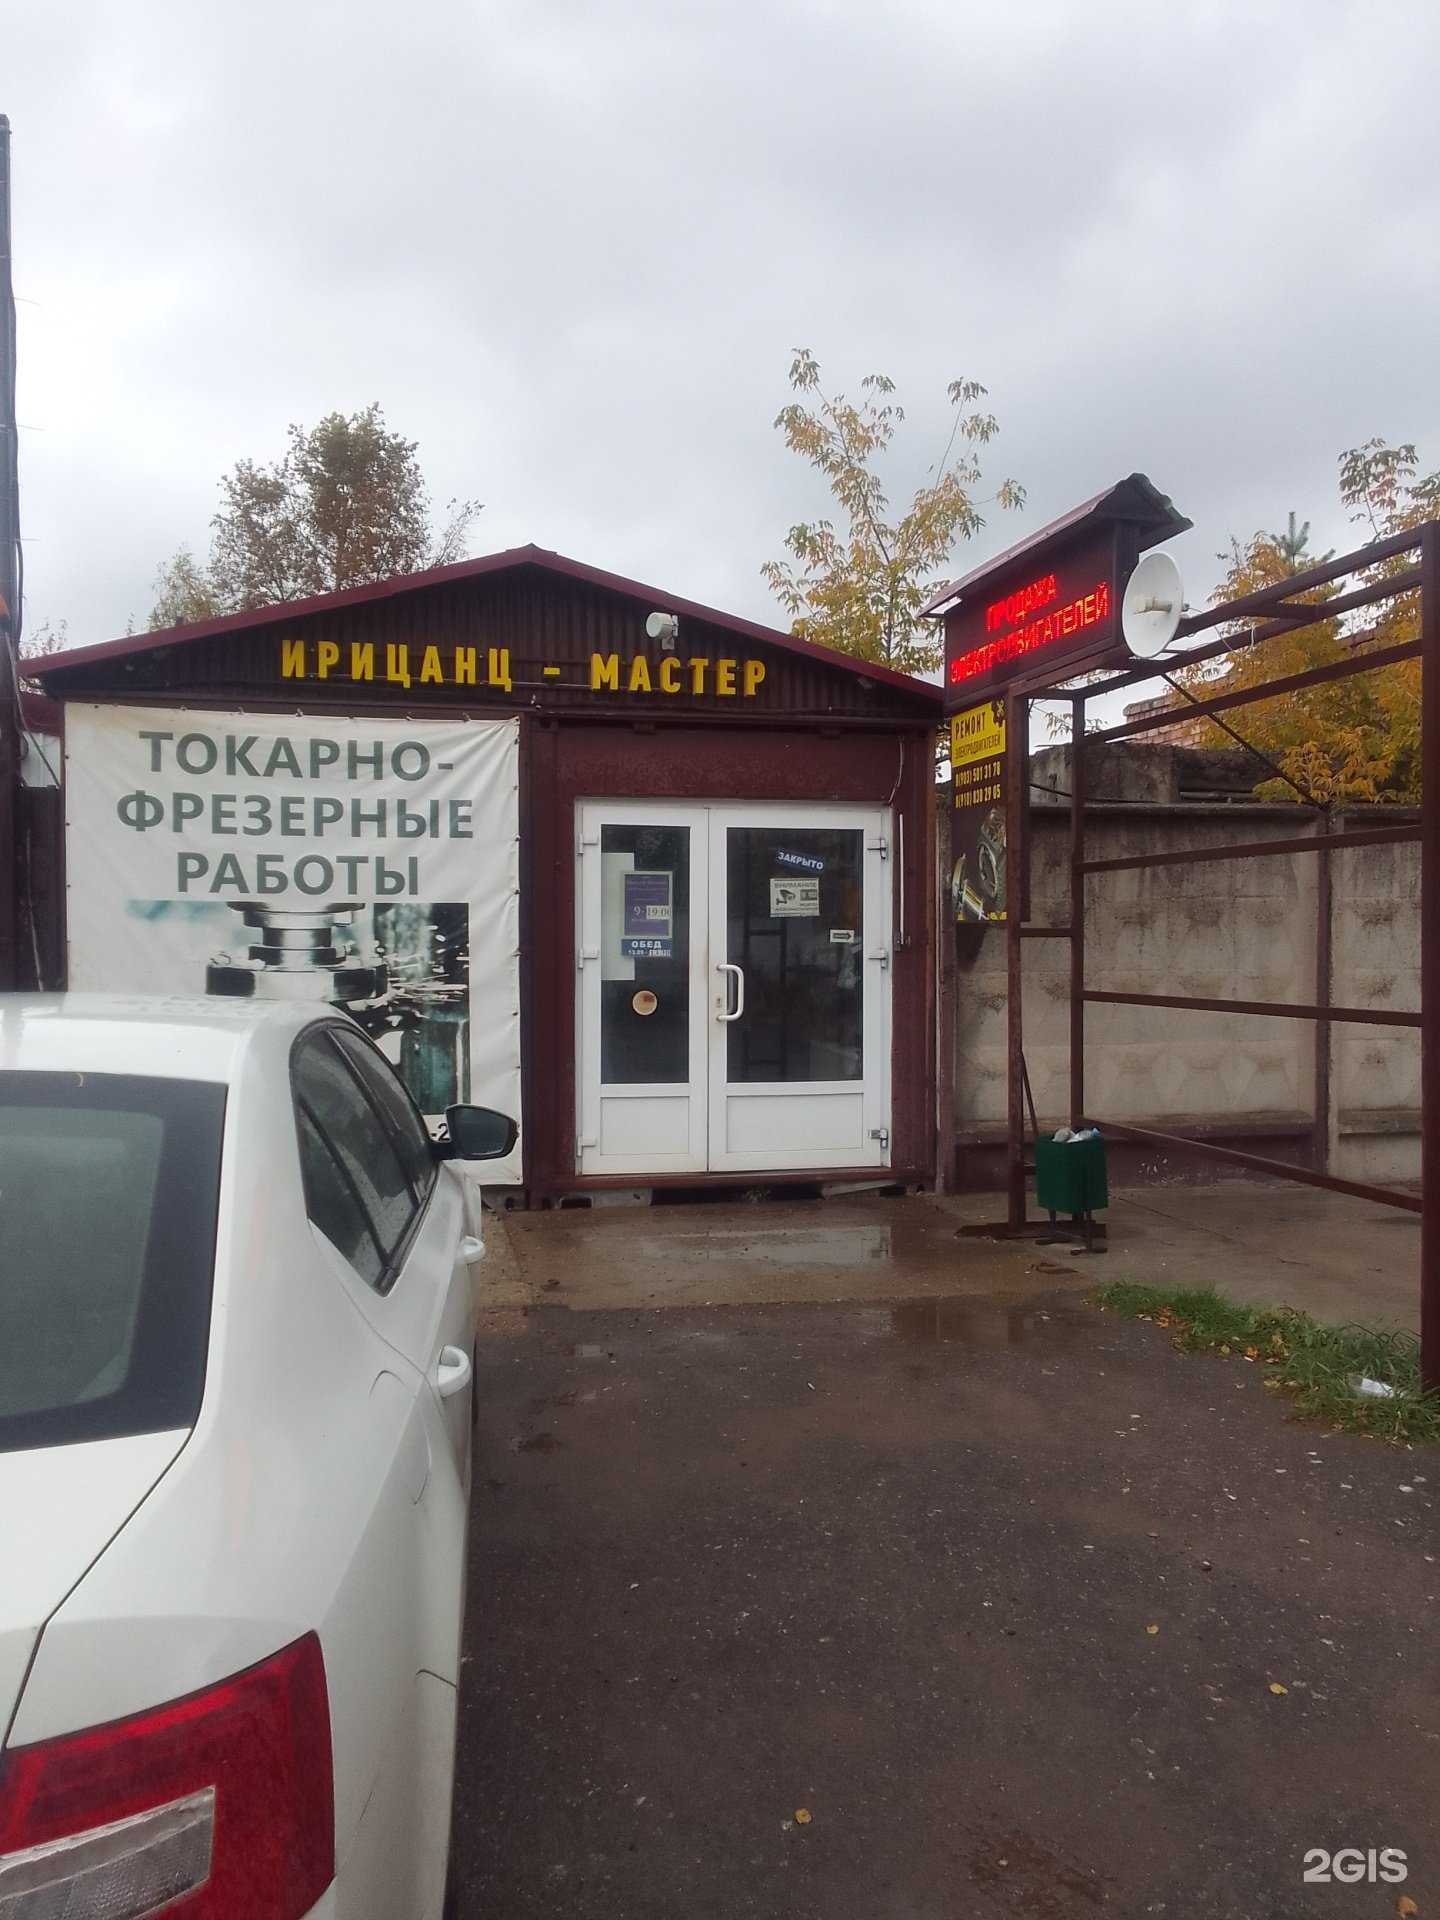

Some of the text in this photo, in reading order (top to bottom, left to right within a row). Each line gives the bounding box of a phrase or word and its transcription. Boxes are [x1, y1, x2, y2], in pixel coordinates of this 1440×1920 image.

[282, 639, 766, 696] ИРИЦАНЦ - МАСТЕР
[955, 711, 986, 741] РЕМОНТ
[139, 730, 454, 781] ТОКАРНО-
[116, 790, 474, 839] ФРЕЗЕРНЫЕ
[177, 852, 419, 895] РАБОТЫ
[778, 851, 824, 870] ЗАКРЫТО
[631, 940, 662, 950] ОБЕД
